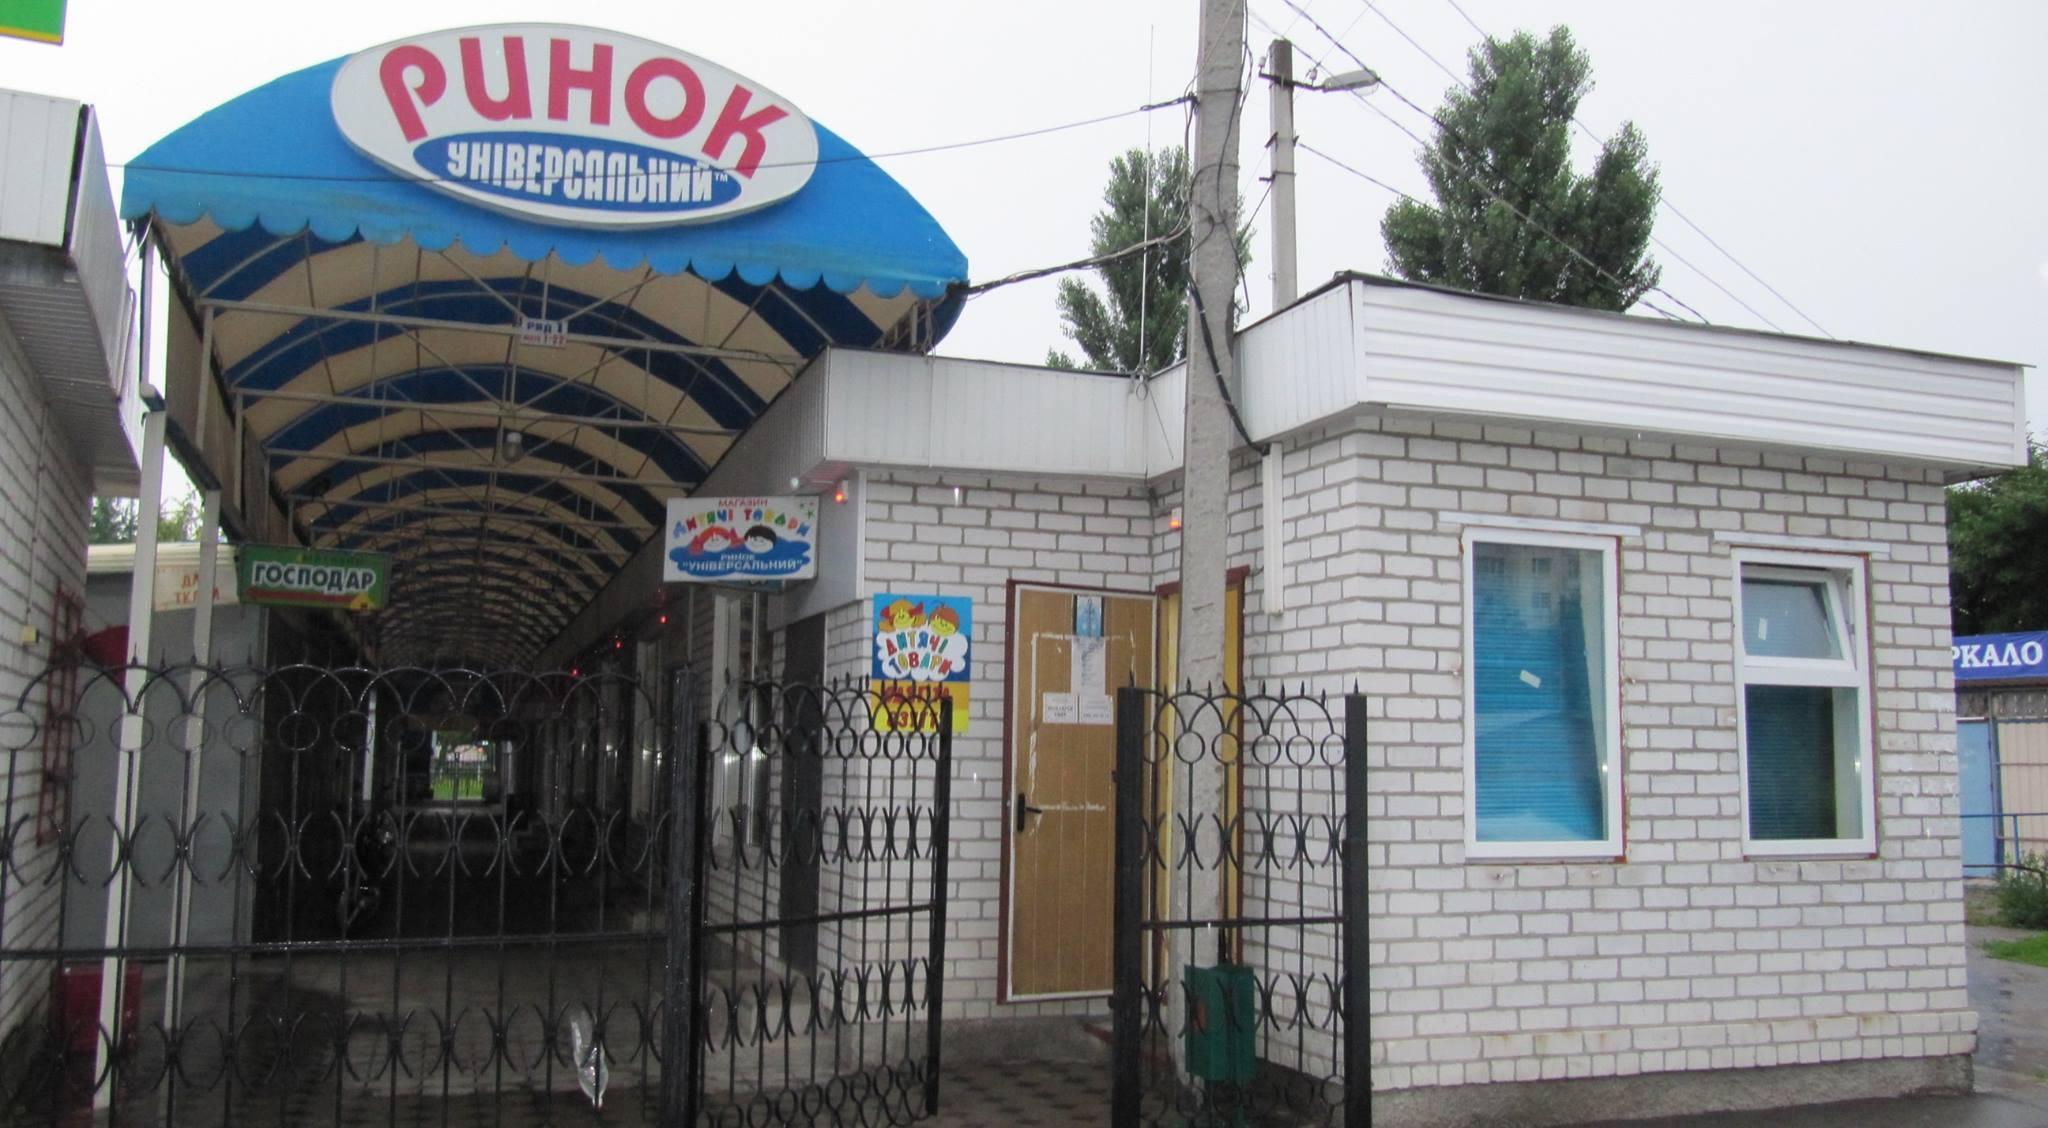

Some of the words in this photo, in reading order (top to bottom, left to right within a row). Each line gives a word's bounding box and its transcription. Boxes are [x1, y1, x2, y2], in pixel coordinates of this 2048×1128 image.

[380, 36, 790, 180] РИНОК
[447, 142, 713, 203] УНІВЕРСАЛЬНИЙ
[718, 498, 768, 507] МАГАЗИН
[673, 509, 734, 538] ДИТЯЧІ
[744, 508, 811, 536] ТОВАРИ
[254, 562, 374, 591] ГОСПОДАР
[885, 631, 948, 656] ДИТЯЧІ
[888, 652, 952, 675] ТОВАРИ
